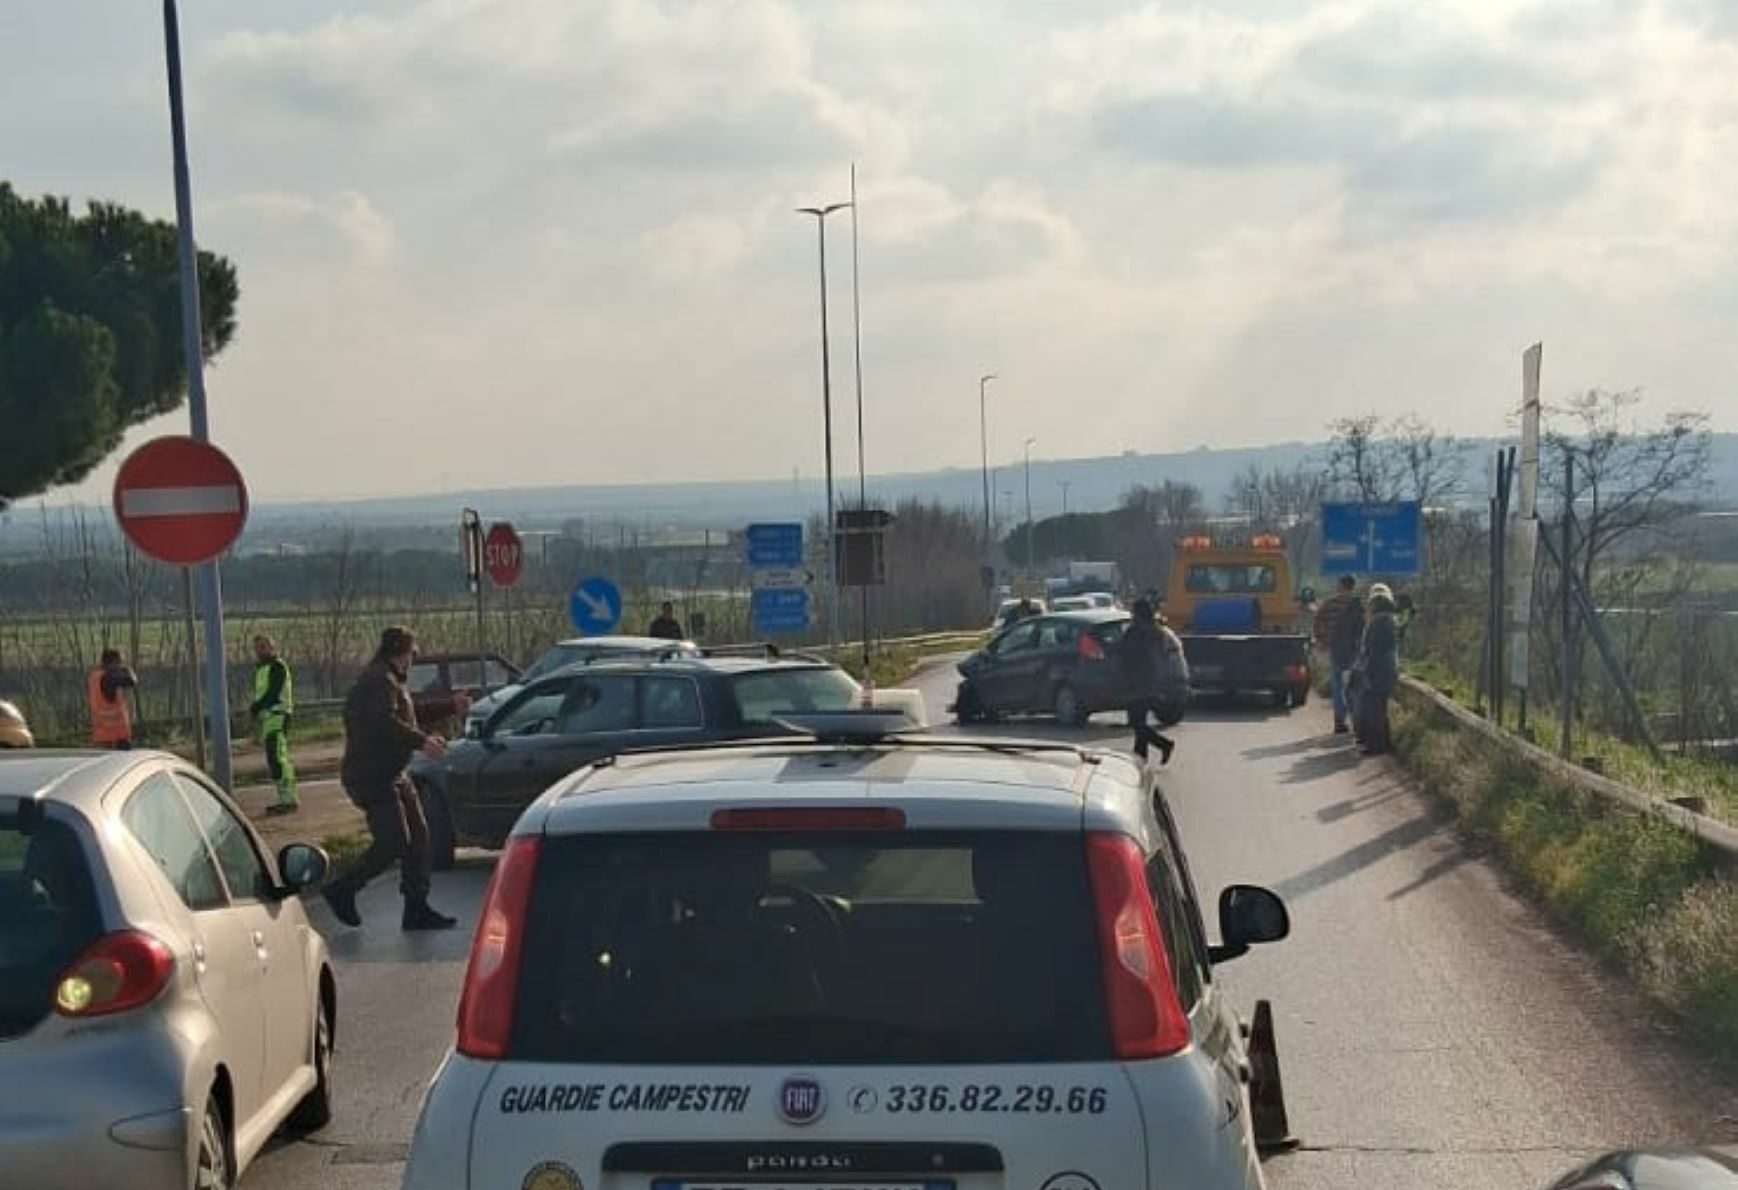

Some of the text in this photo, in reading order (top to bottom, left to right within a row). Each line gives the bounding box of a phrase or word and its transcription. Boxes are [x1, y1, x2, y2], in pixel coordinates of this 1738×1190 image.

[486, 544, 518, 567] STOP
[501, 1084, 749, 1113] GUARDIE CAMPESTRI
[786, 1087, 817, 1112] FIAT
[886, 1084, 1108, 1113] 336.82.29.66
[747, 1154, 850, 1170] panda
